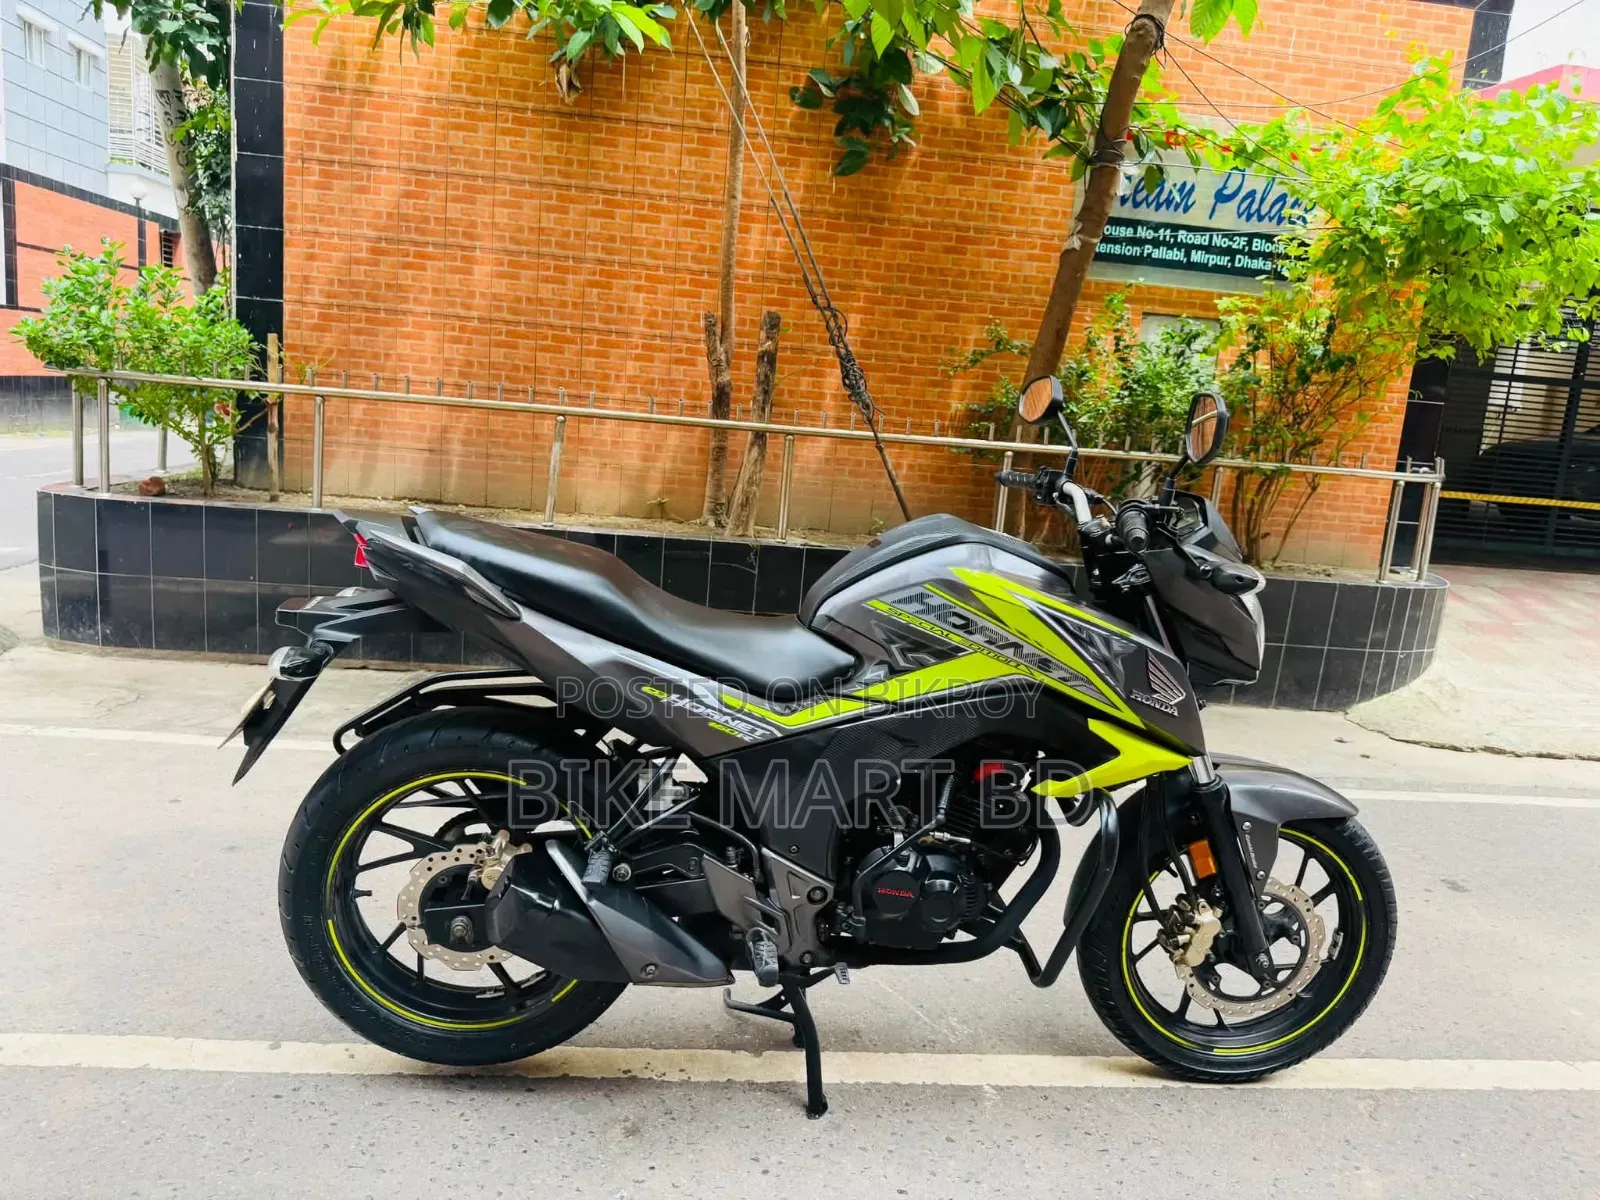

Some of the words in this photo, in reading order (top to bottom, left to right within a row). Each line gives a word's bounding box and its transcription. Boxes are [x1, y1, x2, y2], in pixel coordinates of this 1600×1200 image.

[1103, 225, 1134, 237] ouse
[1137, 226, 1174, 244] No-11,
[1177, 229, 1210, 246] Road
[1212, 234, 1249, 252] No-2F,
[1095, 242, 1141, 257] tension
[1143, 244, 1187, 264] Pallabi,
[1190, 250, 1232, 268] Mirpur,
[887, 607, 953, 640] SPECIAL
[660, 693, 770, 737] HORNET
[1130, 689, 1179, 717] HONDA
[877, 887, 916, 899] HONDA
